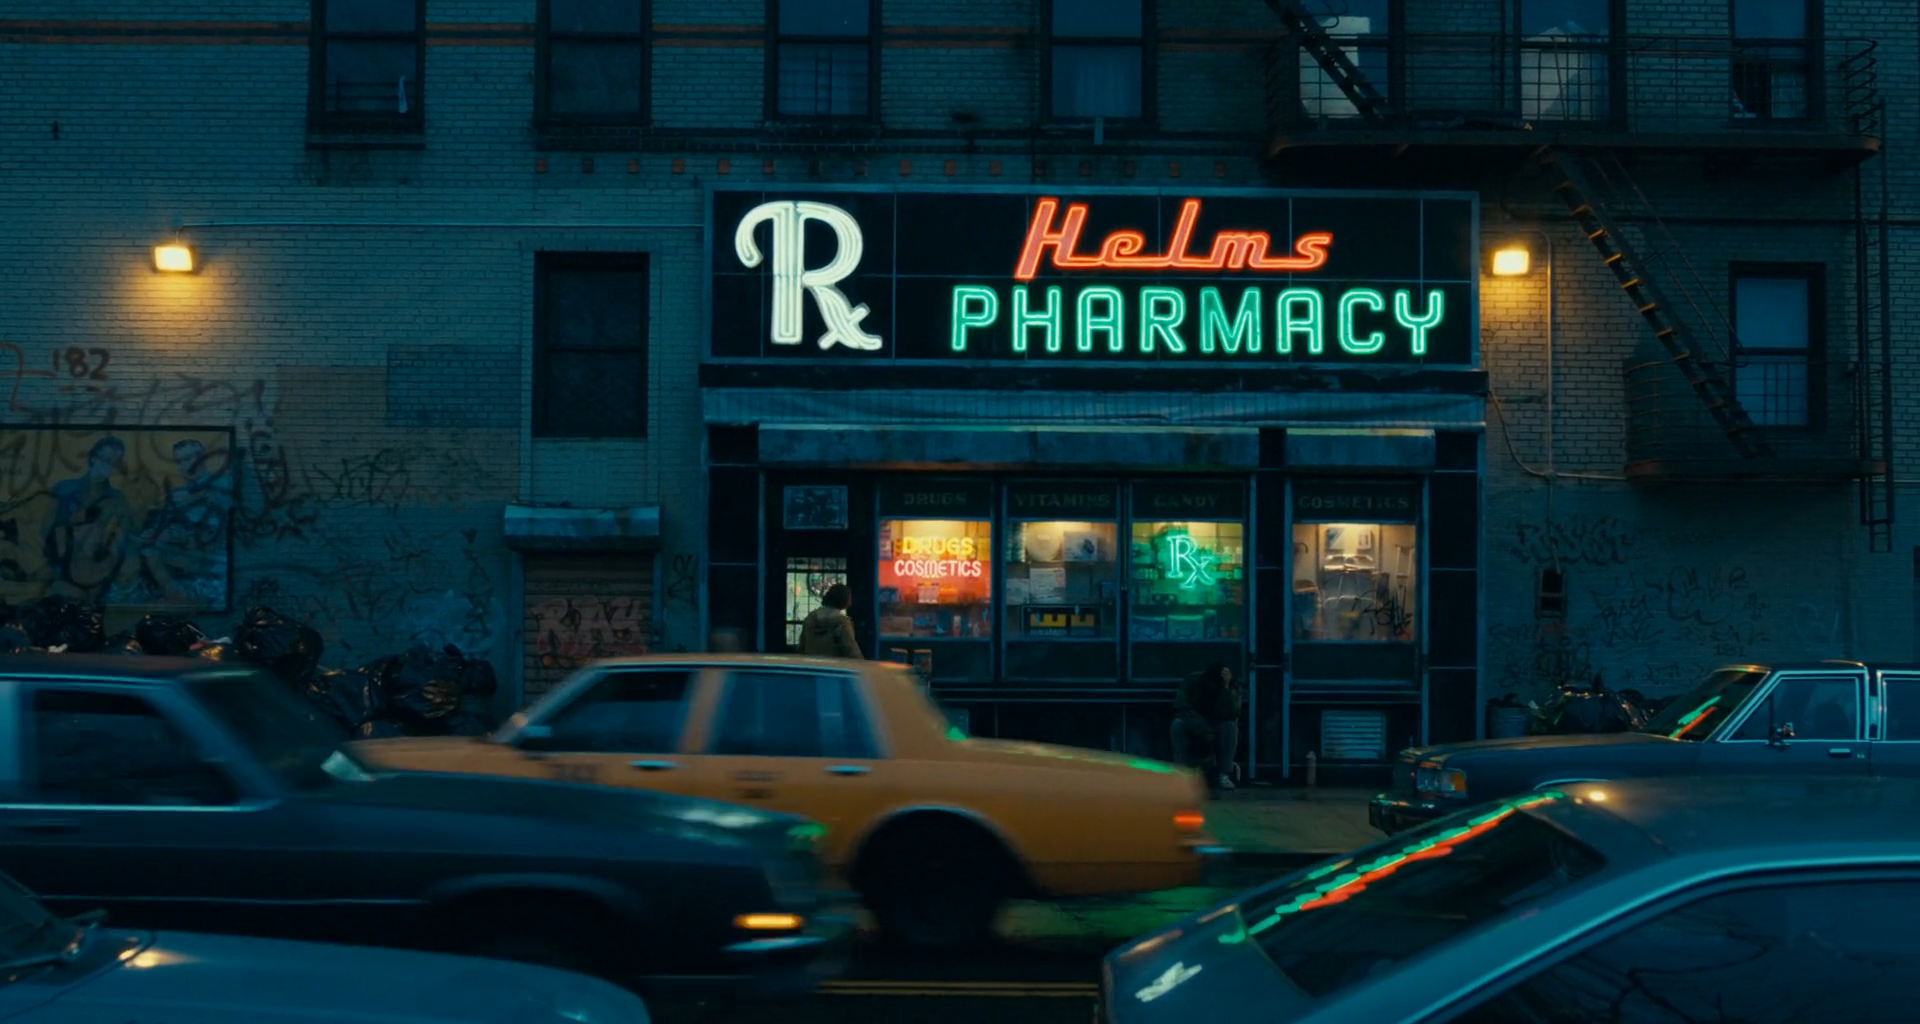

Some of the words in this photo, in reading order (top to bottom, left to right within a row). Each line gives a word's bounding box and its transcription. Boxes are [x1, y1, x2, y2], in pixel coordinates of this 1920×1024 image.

[1015, 197, 1334, 280] Helms
[951, 286, 1445, 354] PHARMACY
[902, 491, 968, 506] DRUGS
[1013, 493, 1112, 508] VITAMINS
[1153, 494, 1220, 508] CANDY
[1297, 495, 1410, 510] COSMETICS
[902, 536, 975, 556] DRUGS
[893, 559, 983, 578] COSMETICS
